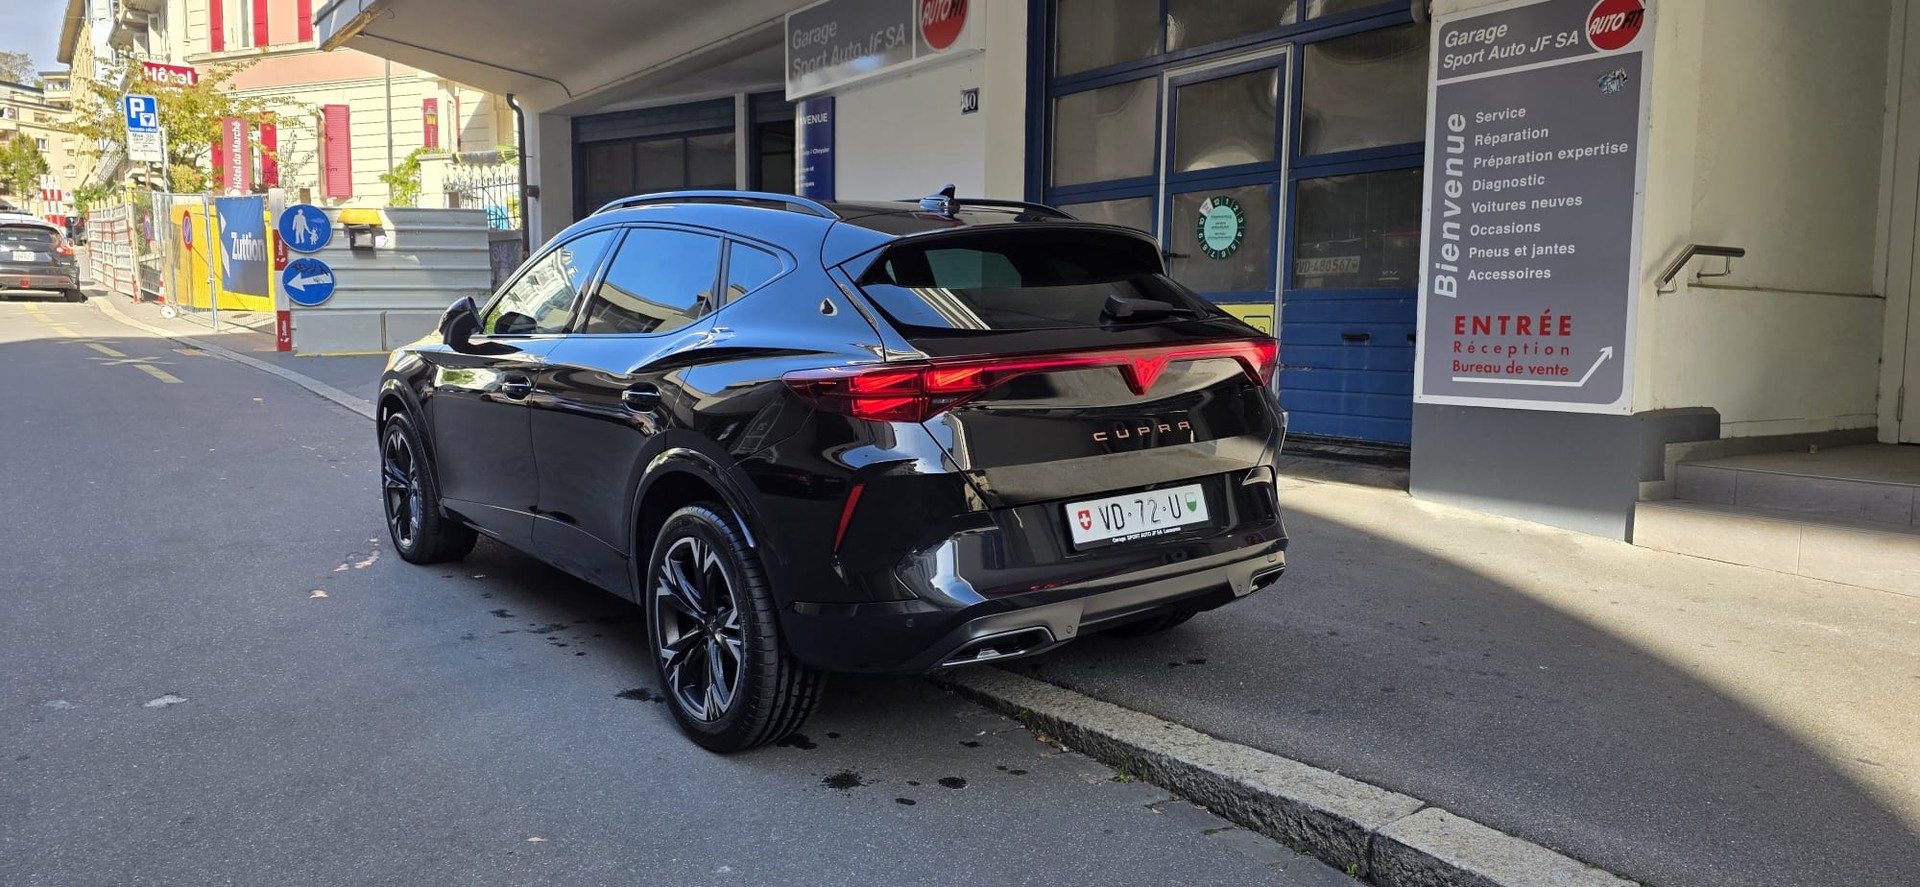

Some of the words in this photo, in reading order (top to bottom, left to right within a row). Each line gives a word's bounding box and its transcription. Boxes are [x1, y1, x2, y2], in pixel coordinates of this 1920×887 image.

[1589, 8, 1645, 35] AUTOFIT
[792, 21, 837, 50] Garage
[831, 41, 862, 66] Auto
[865, 30, 883, 56] JF
[885, 24, 906, 48] SA
[1445, 23, 1508, 48] Garage
[1443, 48, 1485, 70] Sport
[1488, 42, 1526, 61] Auto
[1529, 35, 1552, 53] JF
[1554, 30, 1579, 49] SA
[129, 97, 146, 119] P
[1475, 107, 1526, 123] Service
[232, 121, 241, 153] Marché
[1474, 127, 1549, 146] Réparation
[233, 153, 242, 164] du
[1473, 150, 1553, 169] Préparation
[1557, 141, 1628, 161] expertise
[233, 166, 242, 189] Hôtel
[1472, 173, 1545, 191] Diagnostic
[1434, 113, 1466, 298] Bienvenue
[1471, 197, 1526, 214] Voitures
[1531, 195, 1583, 209] neuves
[1470, 221, 1541, 236] Occasions
[231, 231, 266, 262] Zuttion
[1469, 246, 1510, 259] Pneus
[1514, 244, 1527, 257] et
[1531, 242, 1576, 259] jantes
[1467, 267, 1551, 281] Accessoires
[1454, 308, 1572, 337] ENTRÉE
[1453, 340, 1570, 358] Réception
[1452, 360, 1501, 374] Bureau
[1505, 360, 1524, 375] de
[1528, 362, 1569, 376] vente
[1093, 421, 1191, 442] CUPRA
